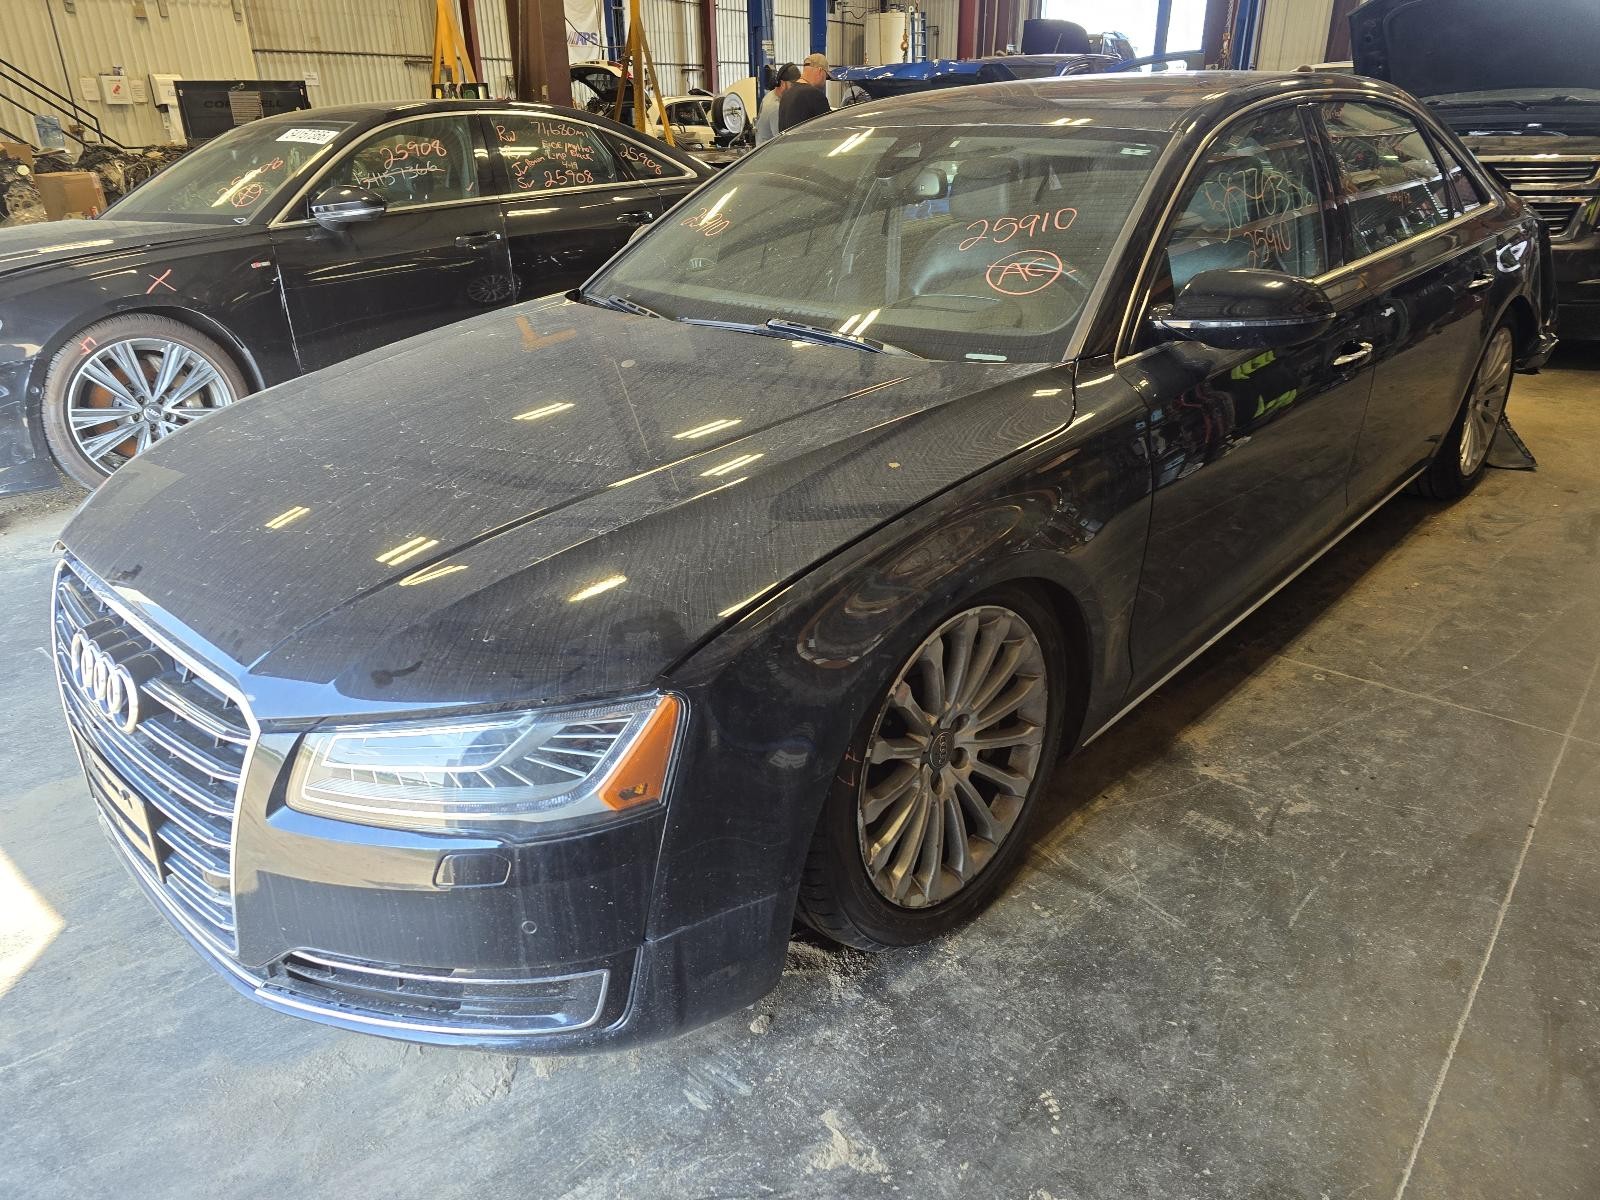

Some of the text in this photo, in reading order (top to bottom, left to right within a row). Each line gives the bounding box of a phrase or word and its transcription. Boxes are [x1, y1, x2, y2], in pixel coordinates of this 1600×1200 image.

[380, 139, 447, 169] 25908
[620, 143, 662, 175] 25908
[544, 169, 594, 188] 25908
[958, 207, 1077, 251] 25910
[1244, 221, 1291, 271] 25910
